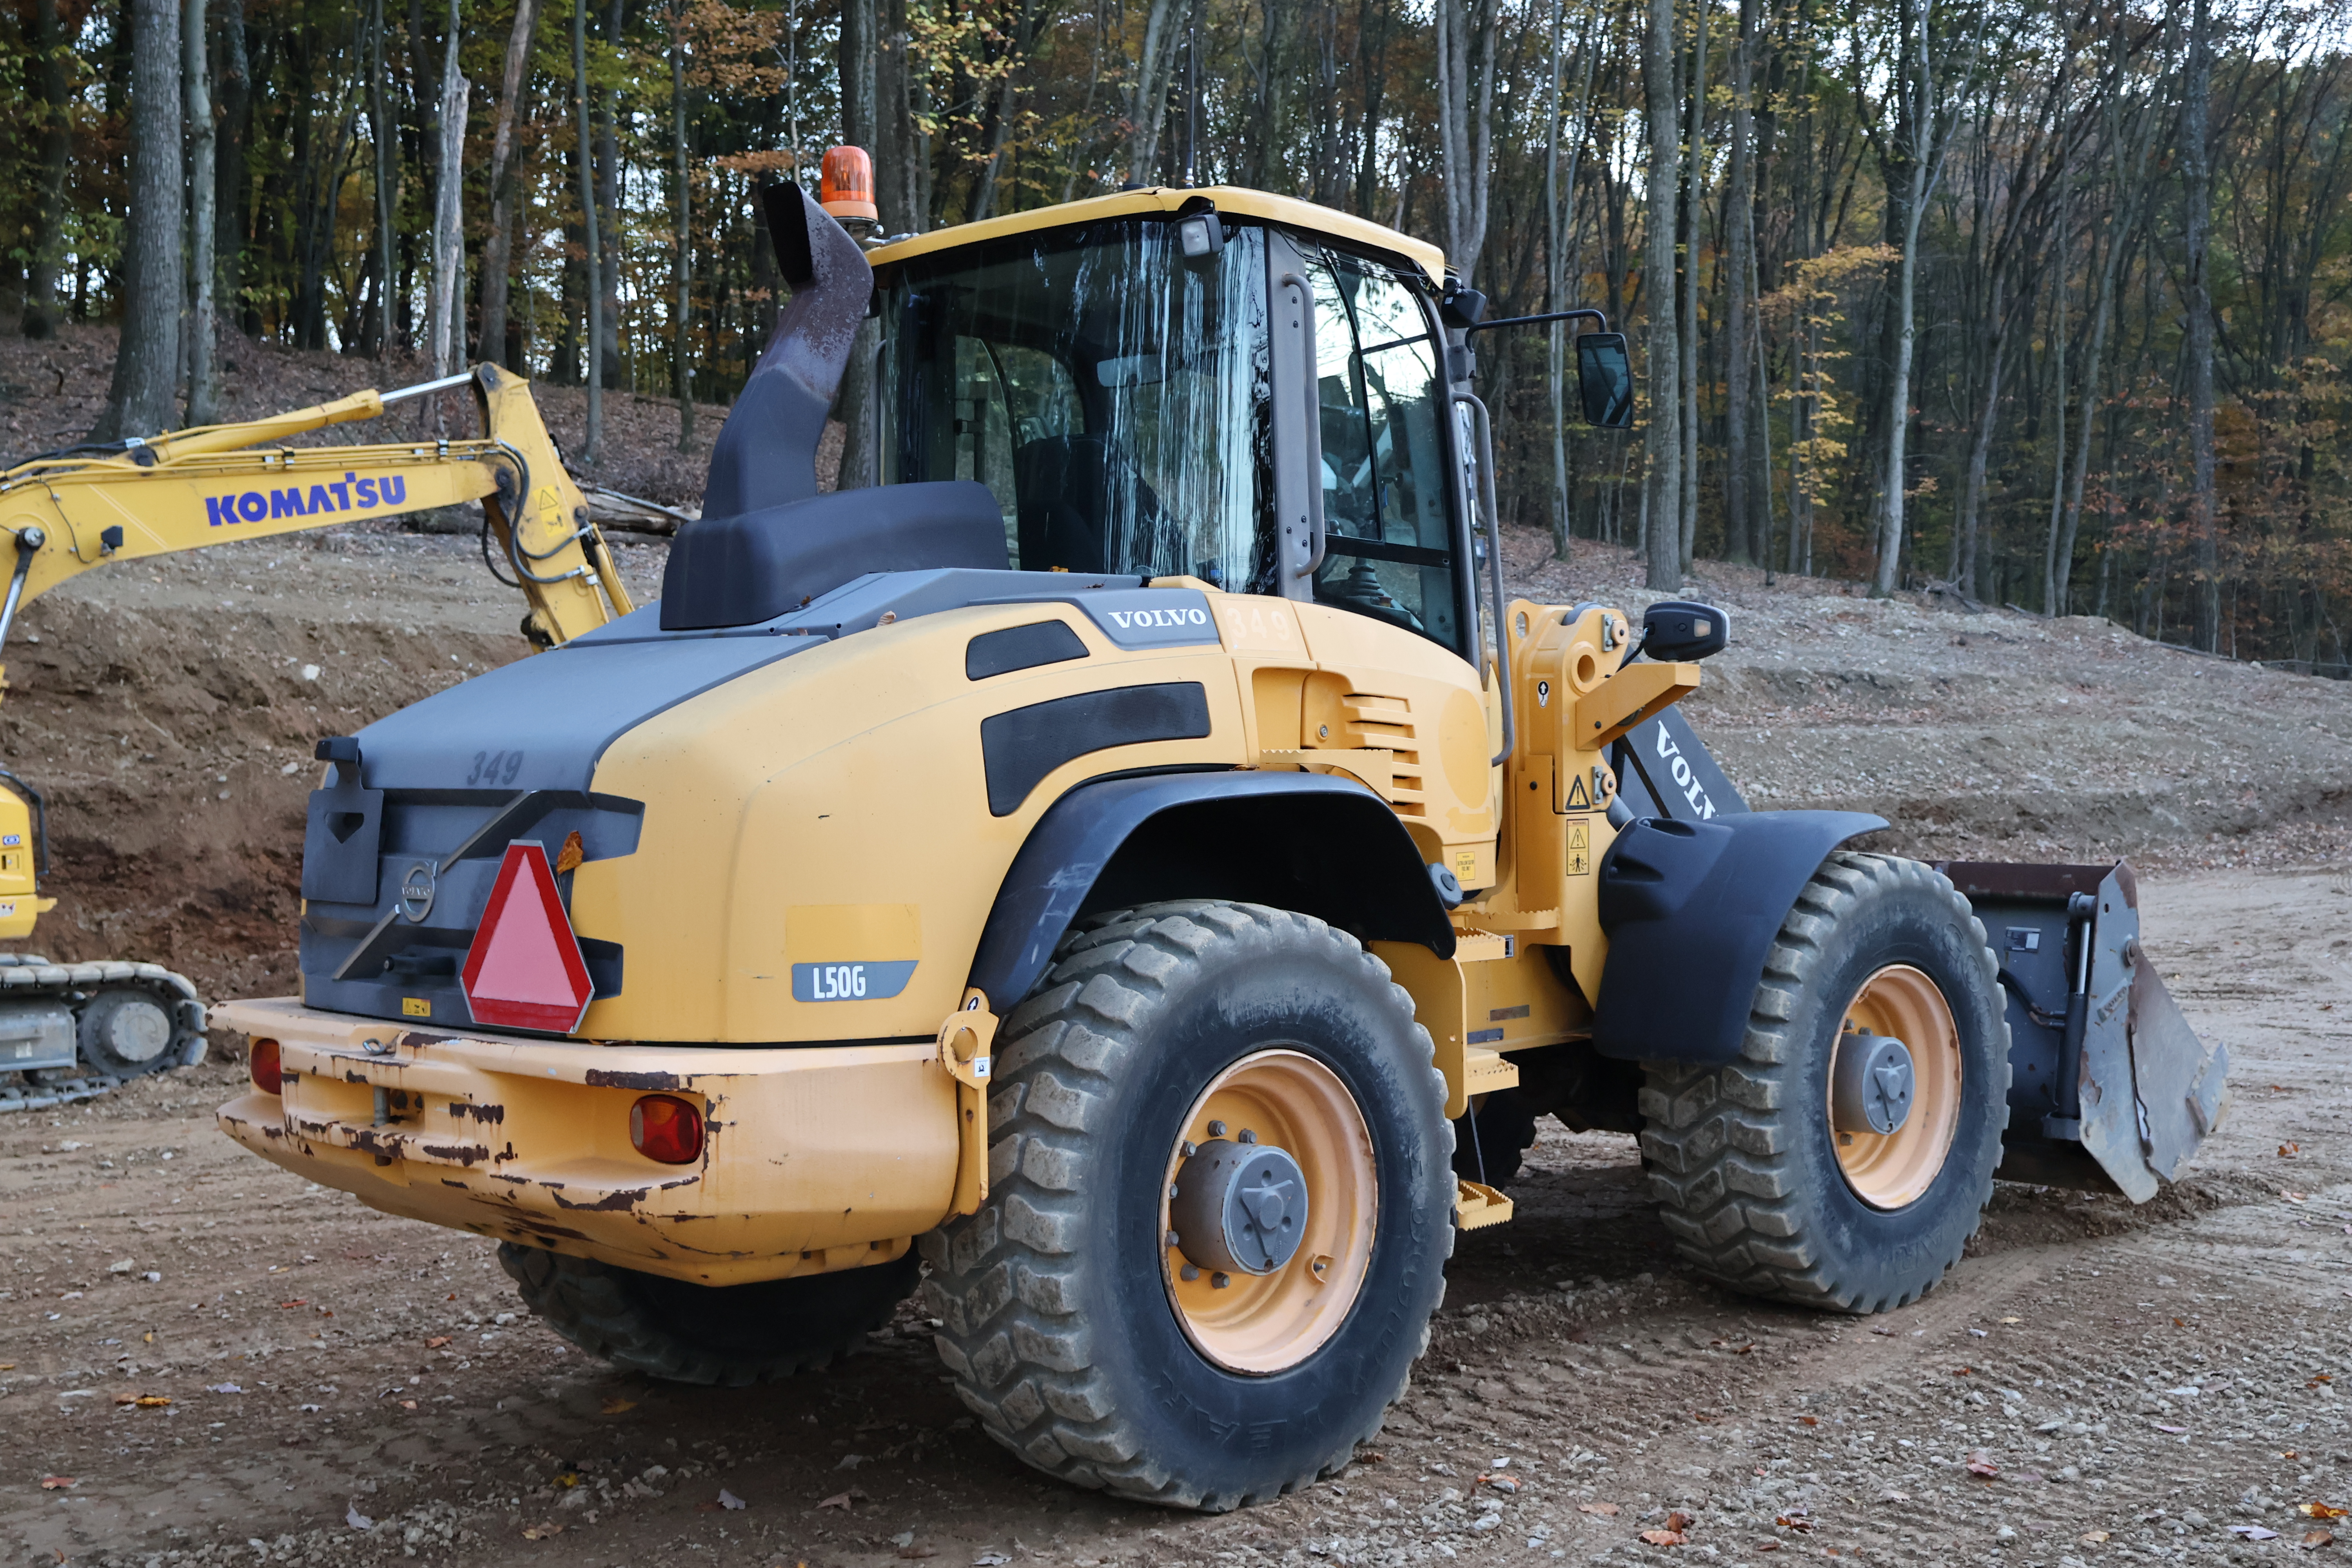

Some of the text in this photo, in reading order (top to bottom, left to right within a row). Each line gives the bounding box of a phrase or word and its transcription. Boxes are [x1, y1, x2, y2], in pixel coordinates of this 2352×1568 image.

[205, 472, 407, 526] KOMATSU
[1108, 608, 1207, 628] VOLVO
[1226, 607, 1291, 641] 349
[467, 750, 524, 785] 349
[1656, 719, 1720, 820] VOLV
[813, 965, 866, 999] L50G
